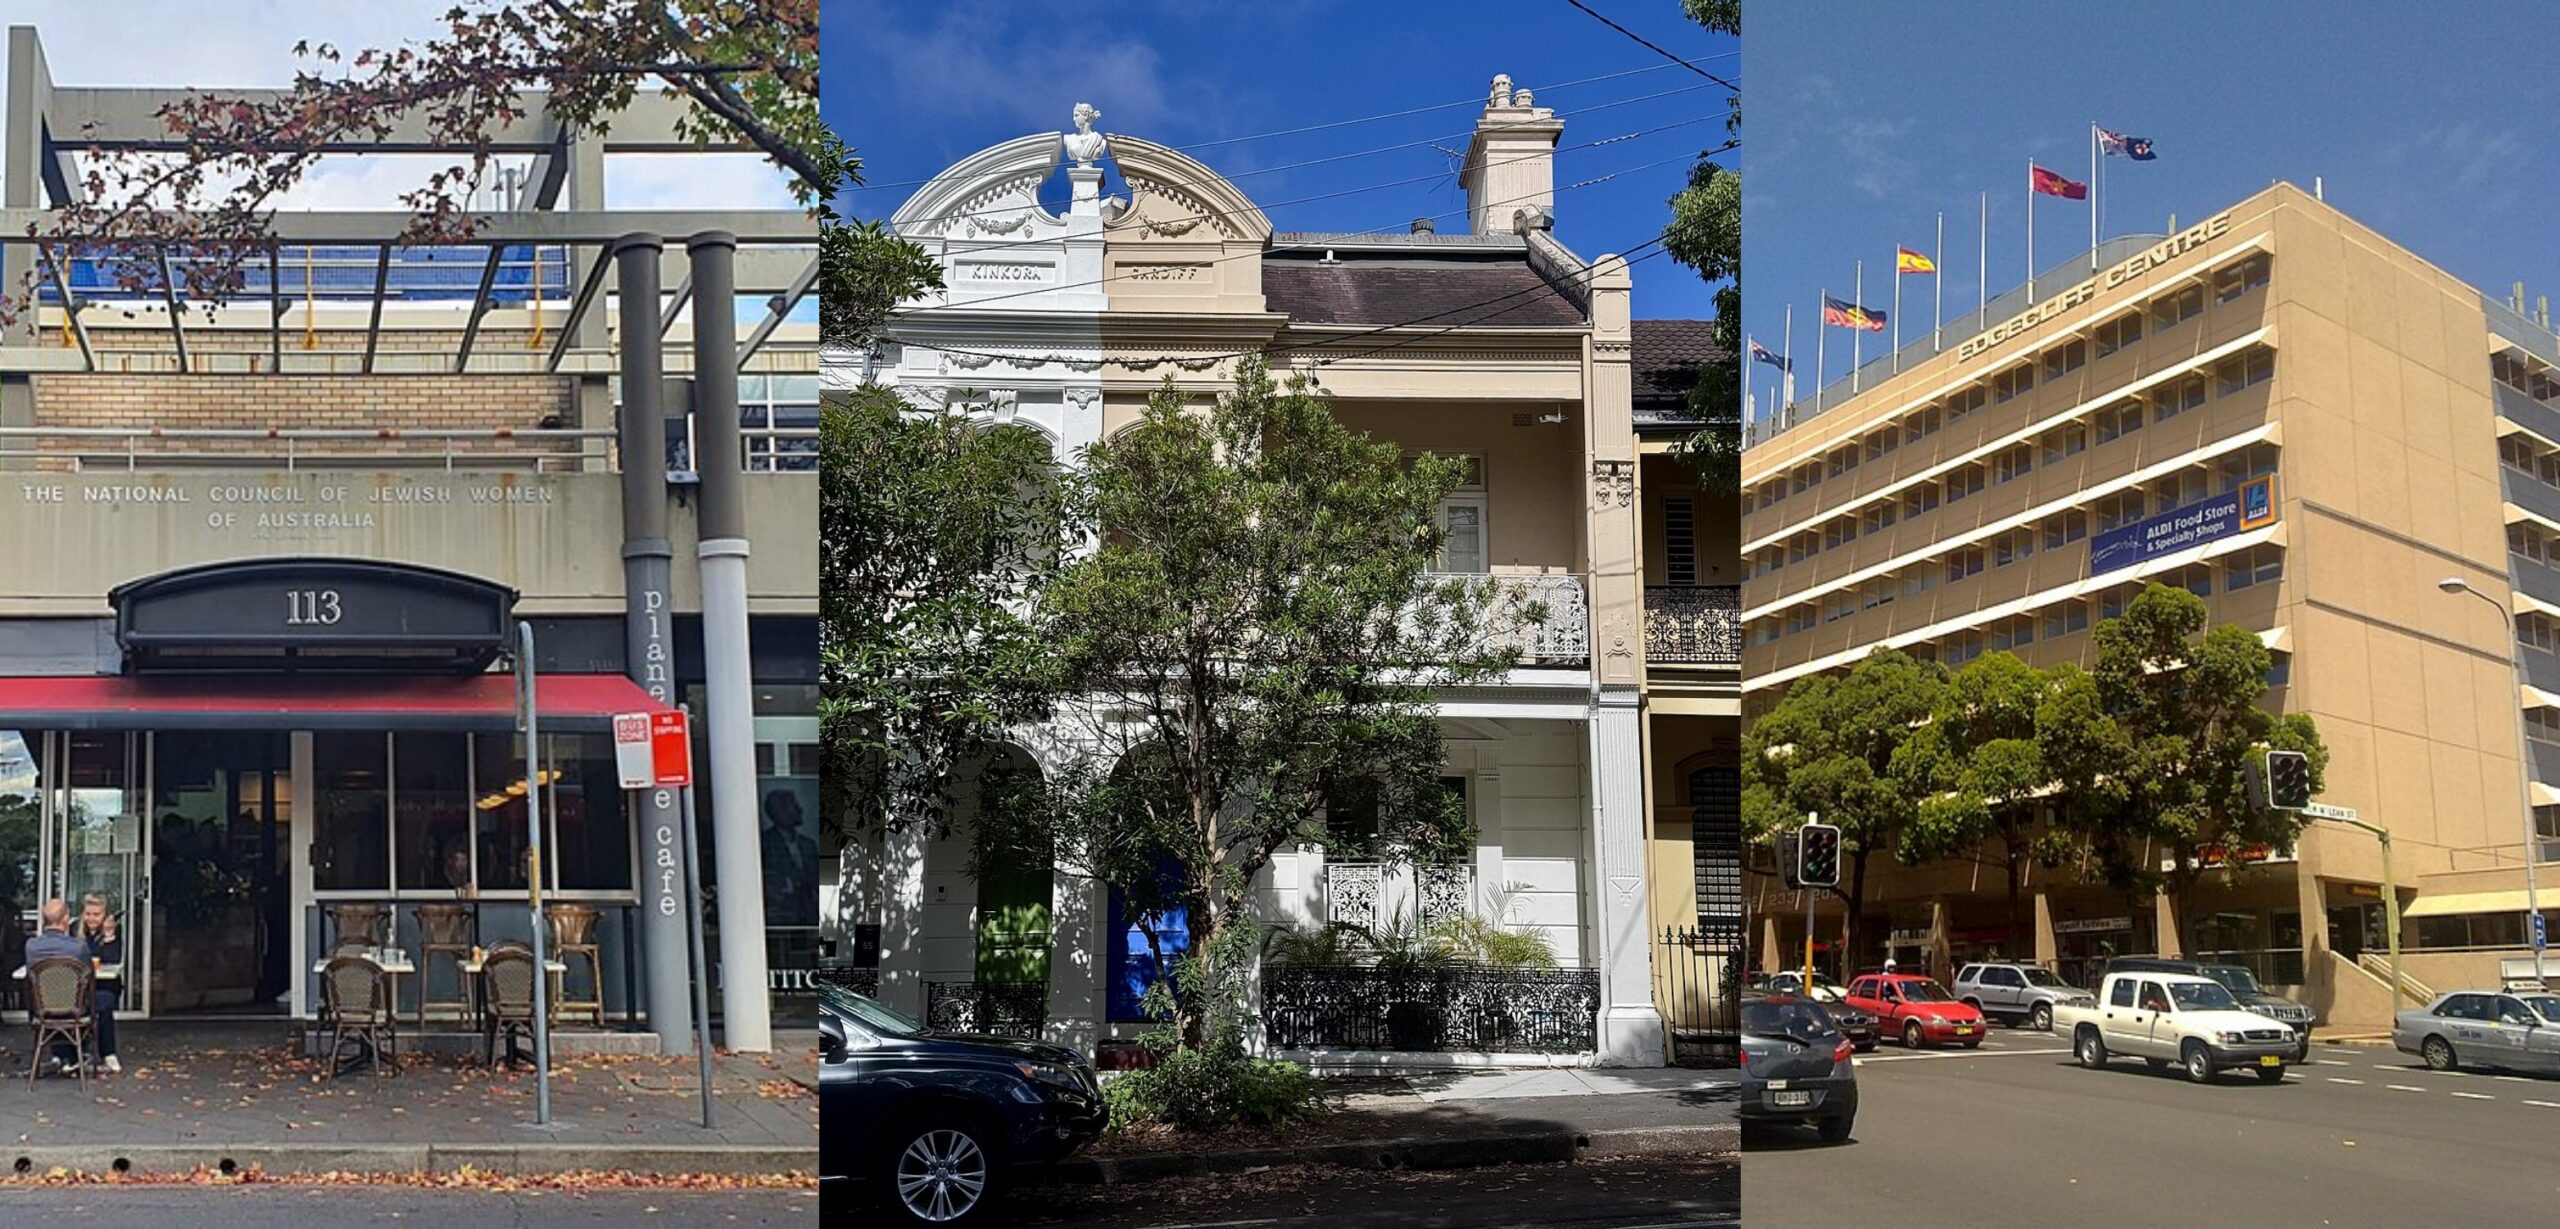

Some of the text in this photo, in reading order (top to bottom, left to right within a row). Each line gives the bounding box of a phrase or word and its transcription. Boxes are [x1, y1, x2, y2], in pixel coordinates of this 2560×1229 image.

[971, 264, 1042, 281] KINKORA
[1130, 267, 1198, 281] CARDIFF
[1958, 214, 2230, 363] EDGECLIFF CENTRE
[24, 486, 553, 502] THE NATIONAL COUNCIL OF JEWISH WOMEN
[207, 513, 375, 527] OF AUSTRALIA
[2147, 502, 2236, 539] ALDI Food Store
[2247, 506, 2268, 520] ALDI
[2155, 530, 2195, 551] Specialty
[2196, 521, 2225, 538] Shops
[286, 591, 342, 625] 113
[656, 826, 677, 916] cafe
